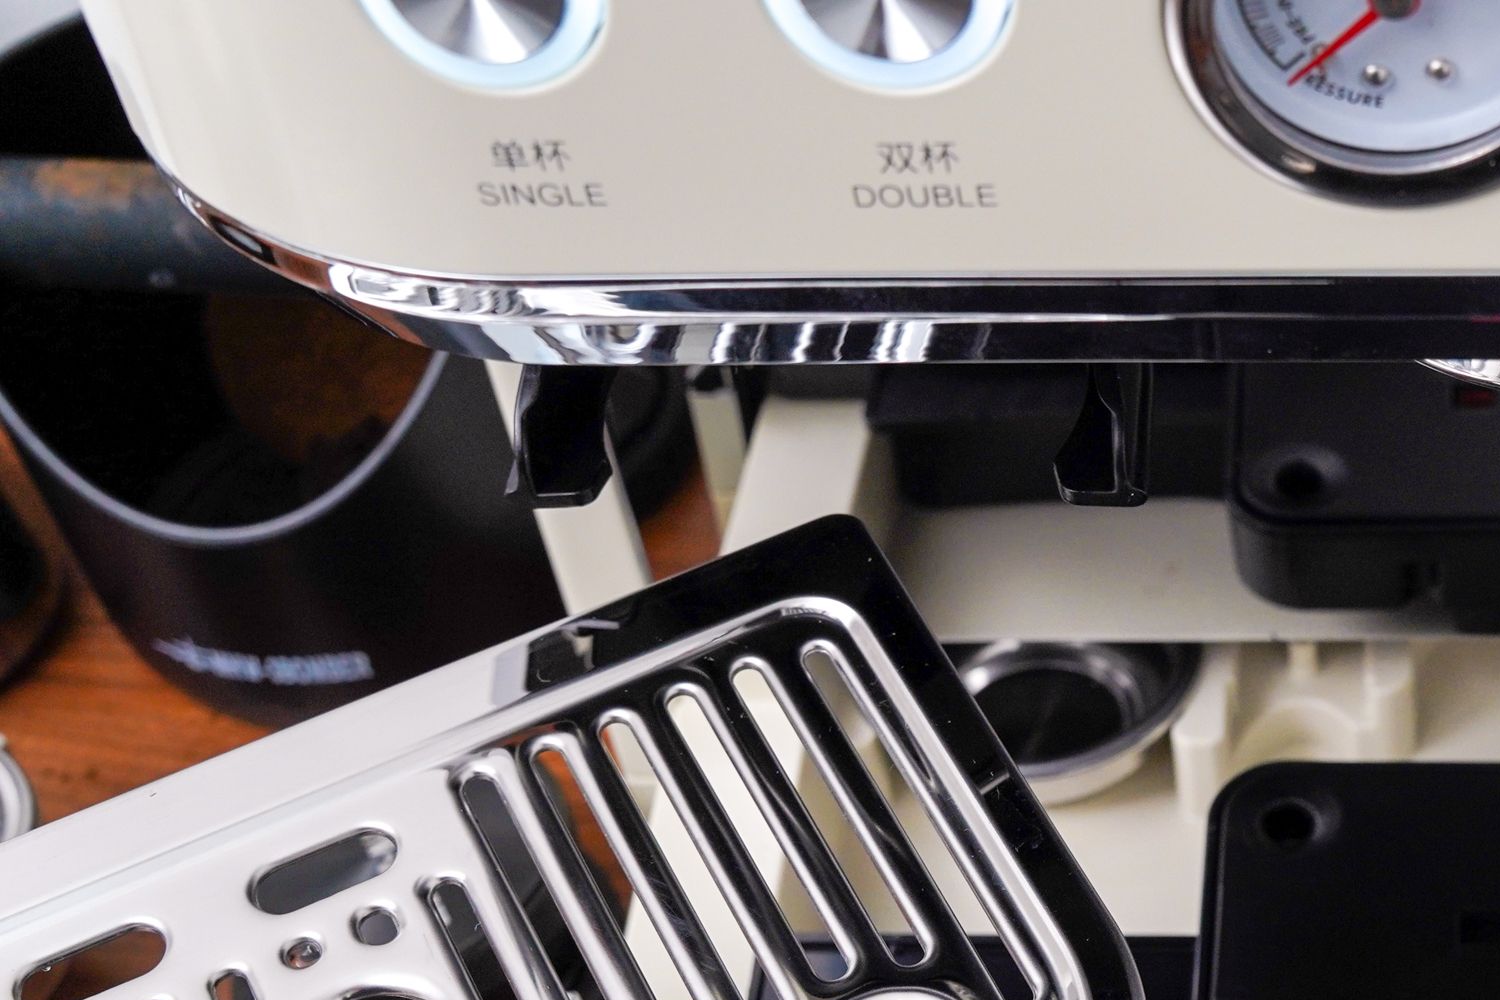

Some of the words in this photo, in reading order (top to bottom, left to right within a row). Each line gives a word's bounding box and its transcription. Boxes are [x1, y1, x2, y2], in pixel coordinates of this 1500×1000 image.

[490, 140, 567, 170] 单杯
[877, 142, 958, 174] 双杯
[477, 182, 606, 207] SINGLE
[852, 183, 997, 208] DOUBLE
